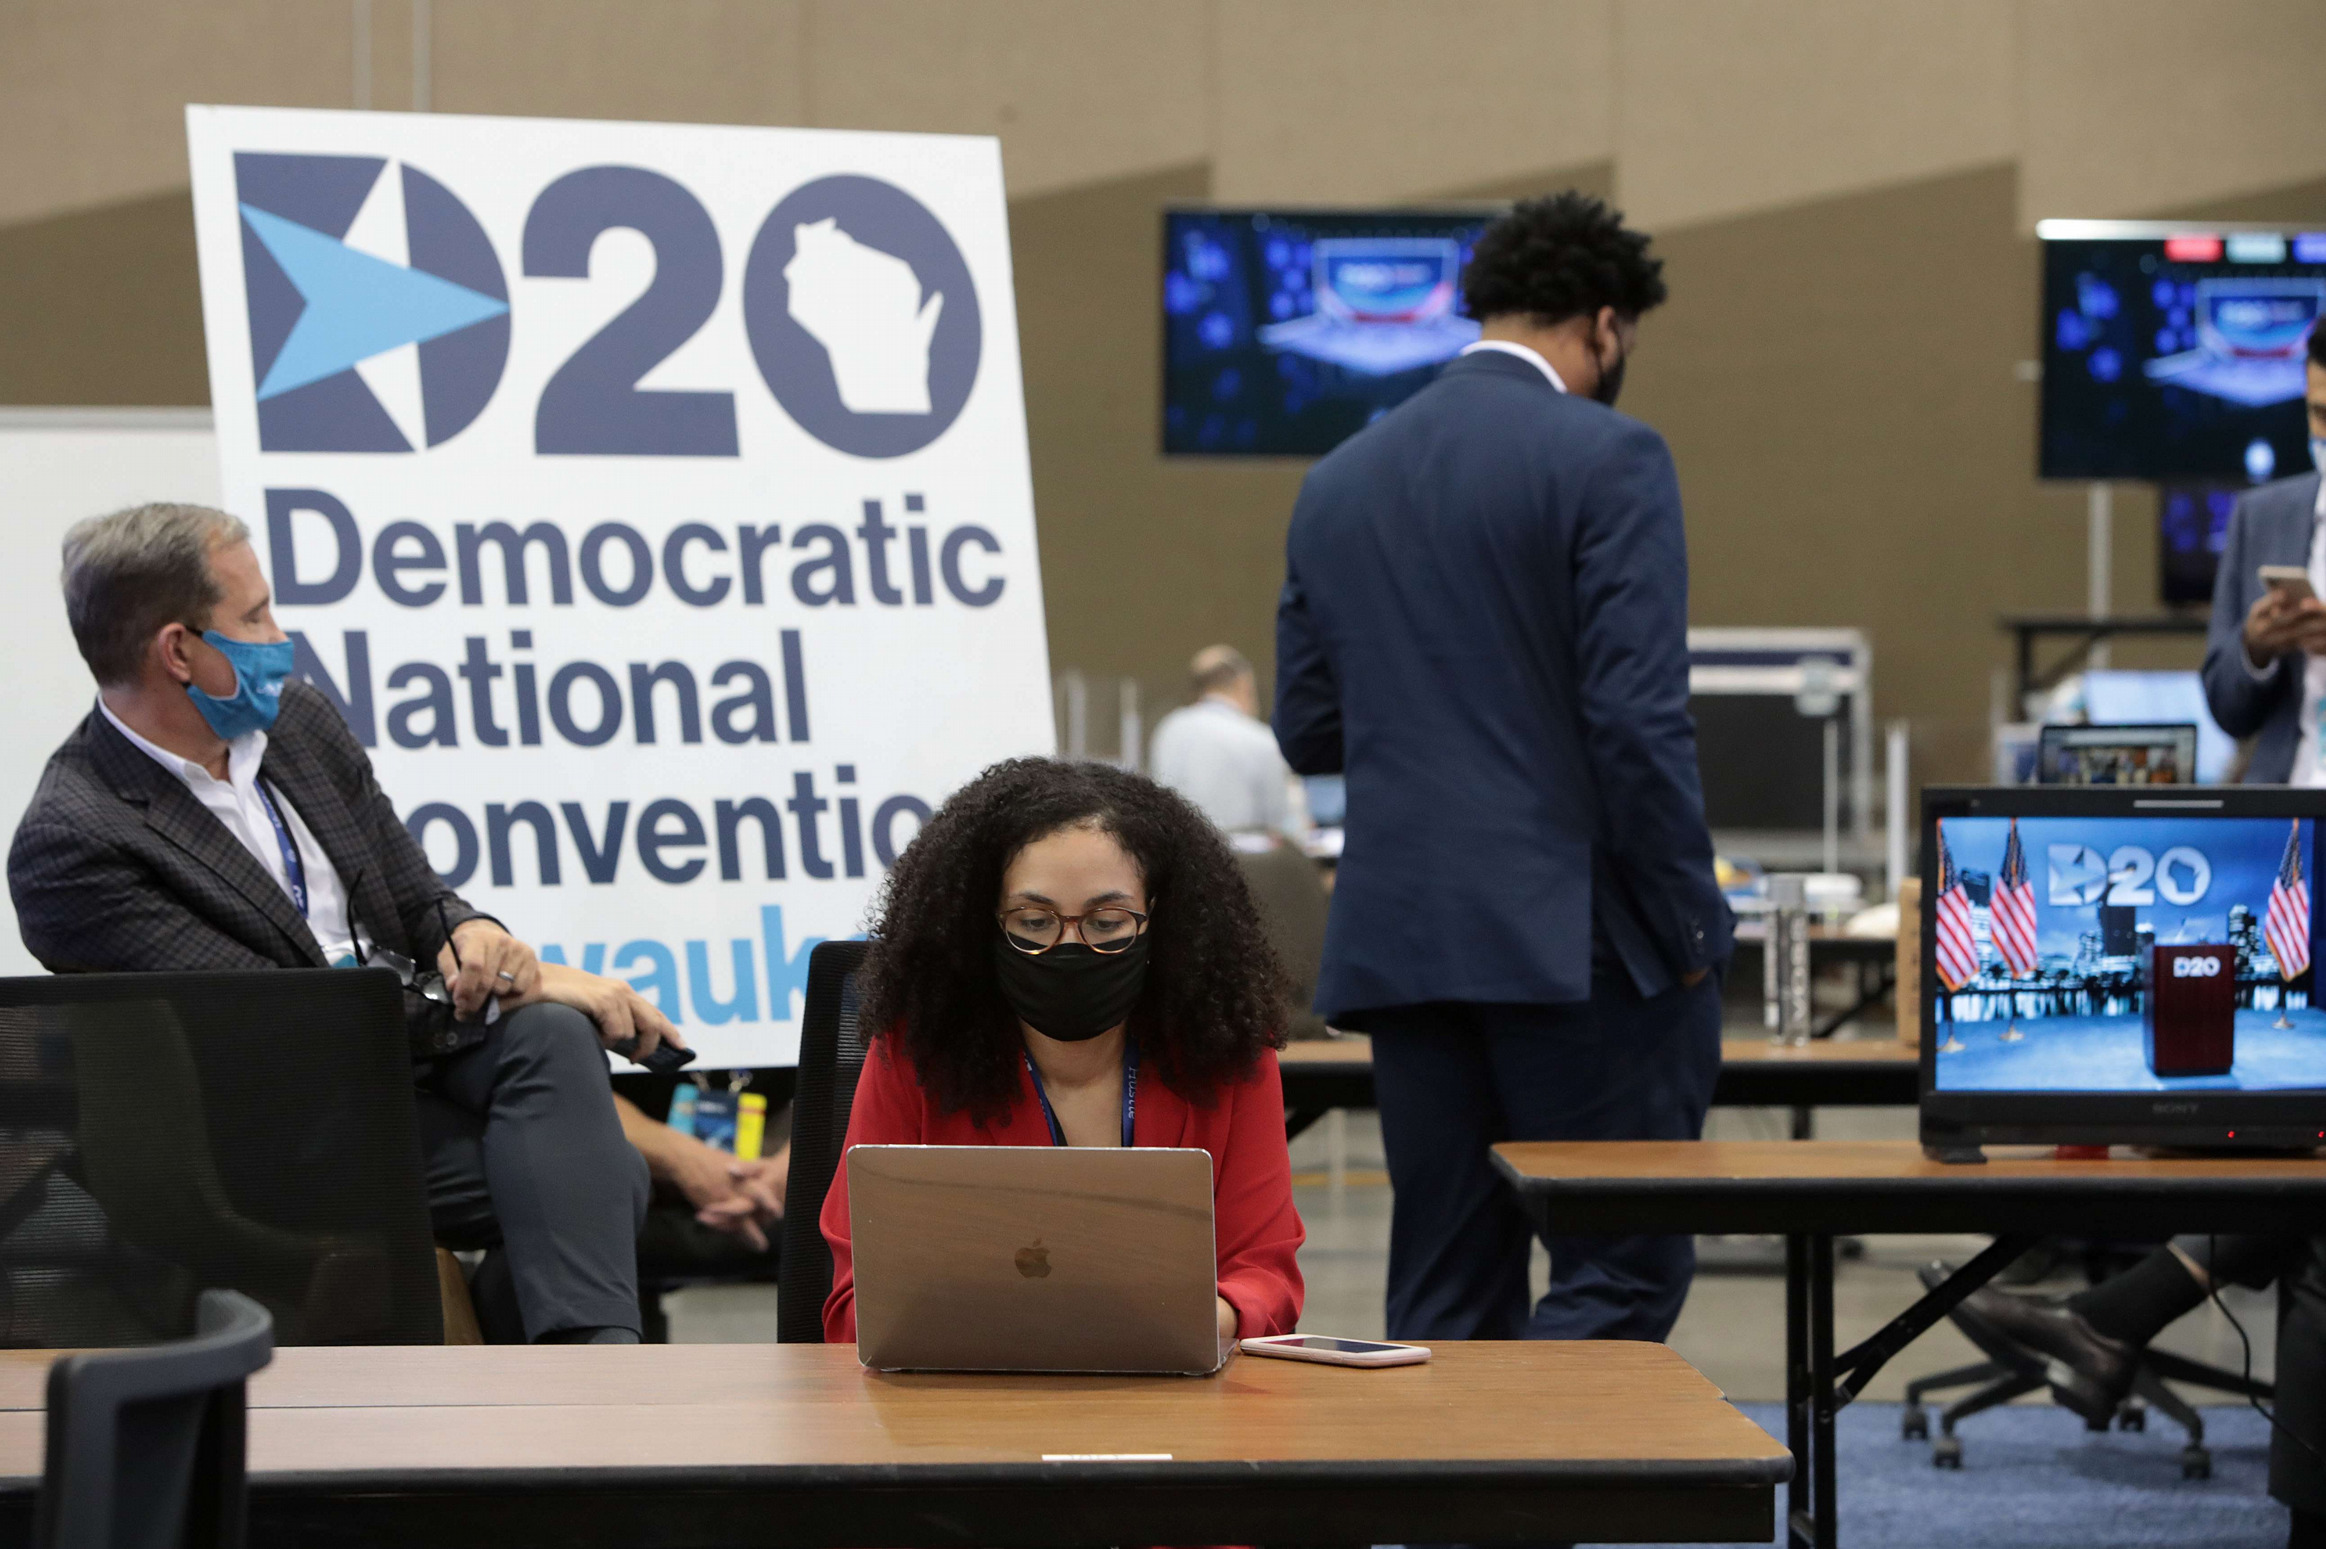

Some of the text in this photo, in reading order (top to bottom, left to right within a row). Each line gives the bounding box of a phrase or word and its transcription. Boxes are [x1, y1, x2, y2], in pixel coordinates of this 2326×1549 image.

[263, 487, 1006, 608] Democratic
[283, 628, 810, 749] National
[404, 764, 934, 889] onventio
[2047, 844, 2212, 906] D20
[2173, 956, 2221, 977] D20
